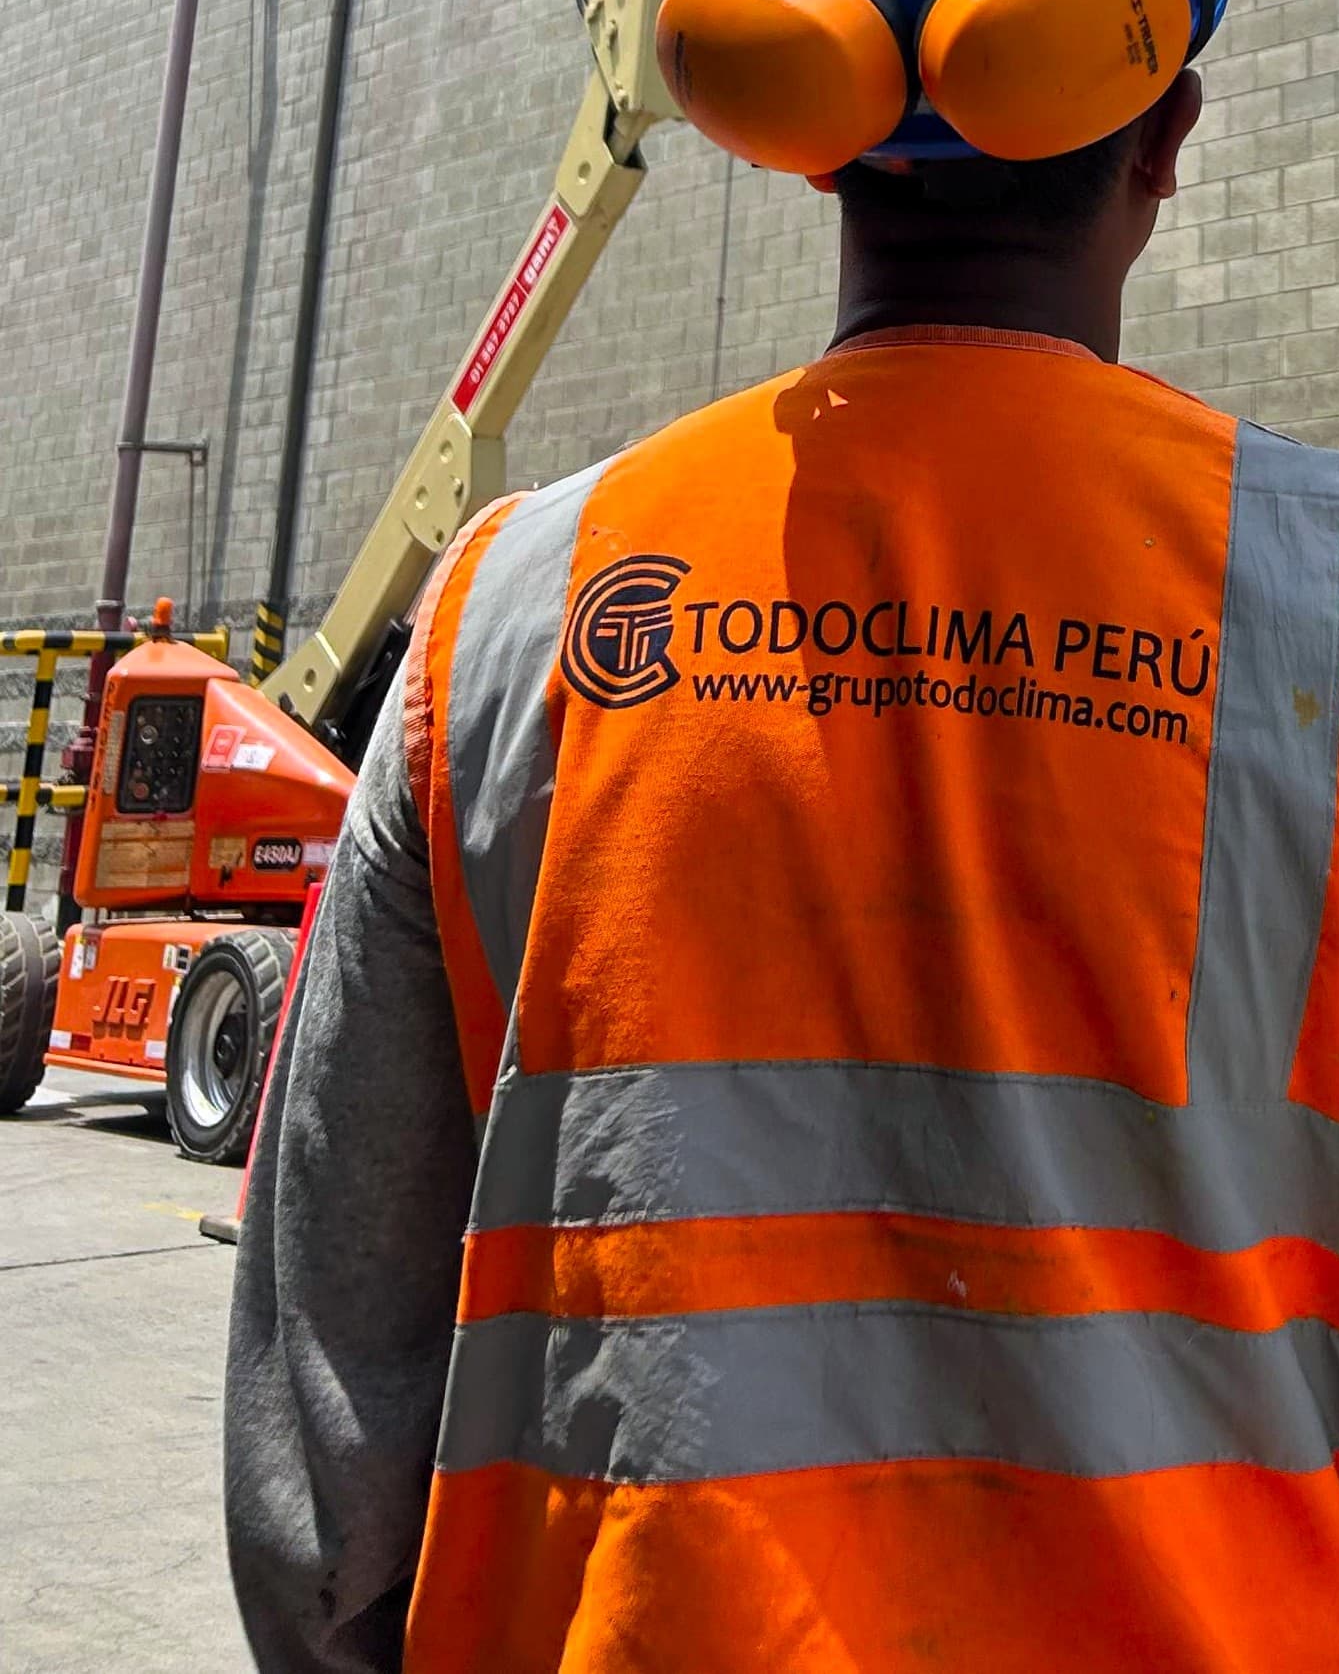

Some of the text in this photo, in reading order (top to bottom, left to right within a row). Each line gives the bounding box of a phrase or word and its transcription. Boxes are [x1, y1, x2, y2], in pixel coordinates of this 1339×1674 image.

[684, 599, 1211, 697] TODOCLIMA PERÚ
[92, 976, 157, 1027] JLG
